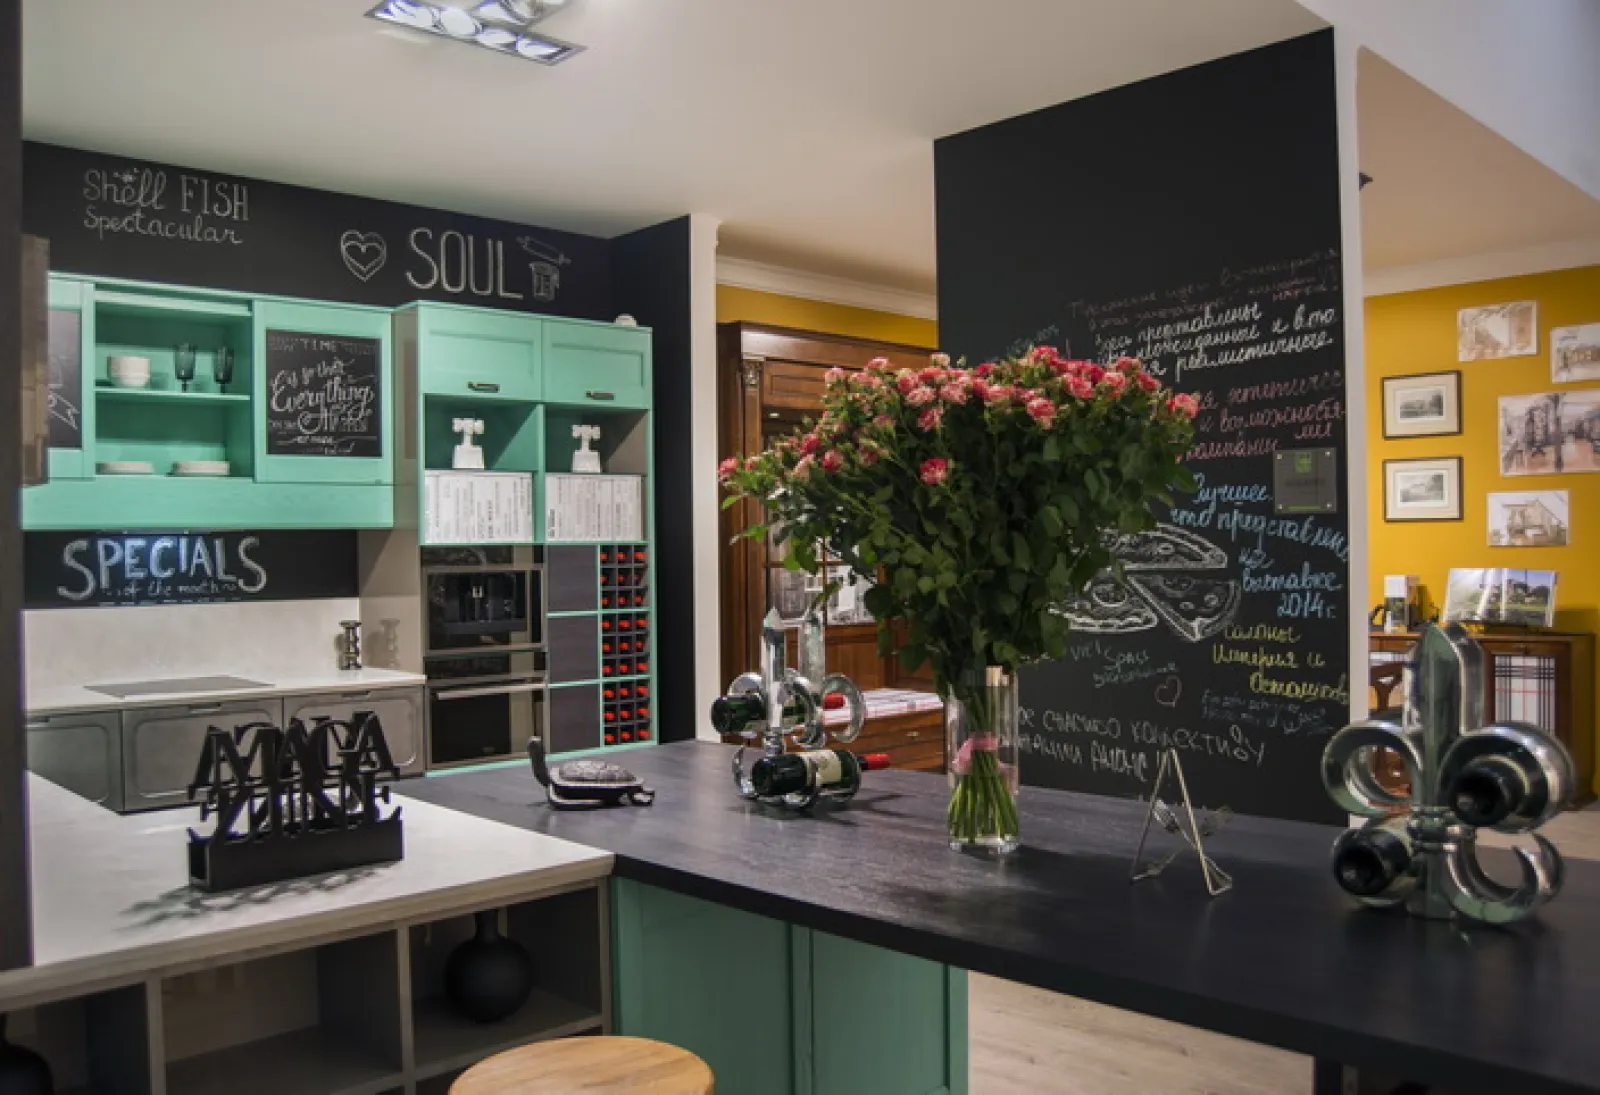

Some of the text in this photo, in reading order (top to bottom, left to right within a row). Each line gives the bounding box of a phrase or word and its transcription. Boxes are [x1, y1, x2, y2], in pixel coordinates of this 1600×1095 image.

[83, 167, 249, 224] Shell FISH
[83, 206, 243, 245] Spectacular
[405, 227, 524, 299] SOUL
[57, 535, 267, 601] SPECIALS
[147, 578, 172, 597] the
